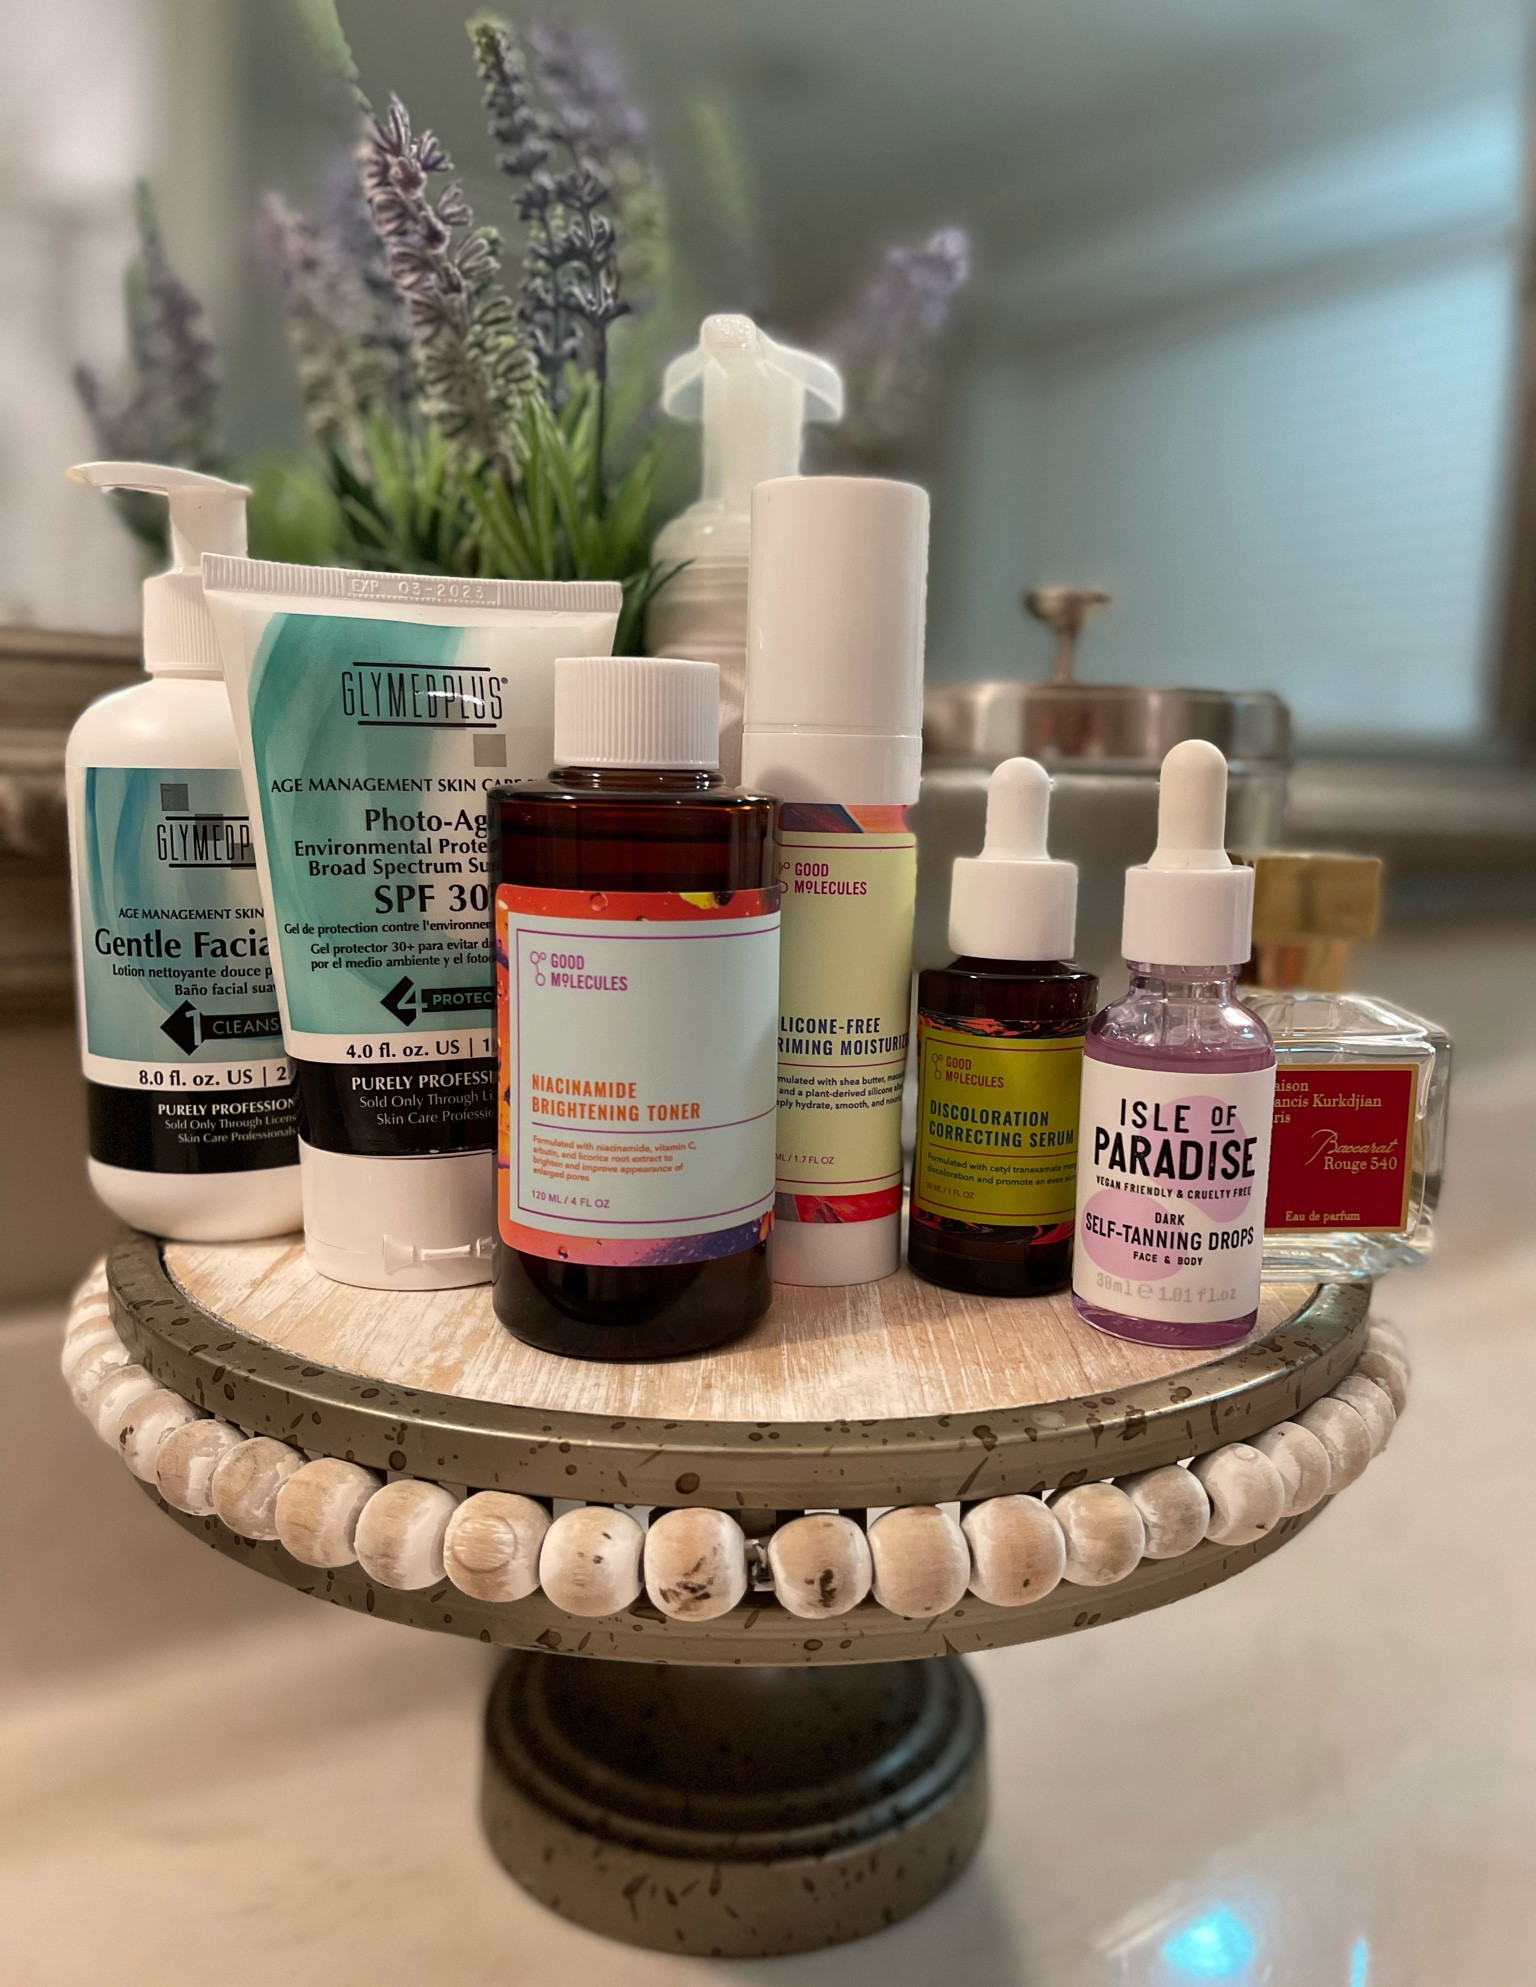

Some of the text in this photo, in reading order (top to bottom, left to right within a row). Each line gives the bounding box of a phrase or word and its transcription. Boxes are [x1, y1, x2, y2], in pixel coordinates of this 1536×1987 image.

[352, 578, 379, 593] EXP
[271, 777, 476, 793] AGE MANAGEMENT SKIN
[157, 824, 250, 861] GLYMEDP
[294, 837, 432, 857] Environmental
[308, 858, 462, 879] Broad Spectrum
[794, 862, 829, 877] GOOD
[374, 884, 435, 914] SPF
[119, 907, 264, 920] AGE MANAGEMENT SKIN
[284, 923, 300, 934] Gel
[302, 923, 315, 934] de
[318, 922, 378, 937] protection
[382, 921, 420, 933] contre
[95, 928, 181, 958] Gentle
[311, 939, 478, 957] Gel protector 30+ para evitar
[311, 959, 329, 972] por
[332, 958, 342, 968] el
[345, 956, 383, 968] medio
[386, 955, 440, 967] ambiente
[443, 956, 450, 968] y
[453, 953, 463, 964] el
[550, 953, 585, 970] GOOD
[112, 964, 261, 982] Lotion nettoyante douce
[175, 982, 248, 996] Baño facial
[213, 1015, 279, 1035] CLEANS
[780, 1016, 881, 1035] LICONE-FREE
[346, 1039, 460, 1059] 4.0 fl. oz. US
[946, 1056, 972, 1071] GOOD
[139, 1069, 253, 1086] 8.0 fl. oz. US
[352, 1075, 413, 1091] PURELY
[532, 1073, 637, 1099] NIACINAMIDE
[817, 1077, 837, 1086] with
[840, 1077, 860, 1086] shea
[862, 1076, 886, 1085] butter,
[360, 1090, 479, 1110] Sold Only Through
[779, 1087, 795, 1096] and
[805, 1088, 866, 1099] plant-derived
[868, 1087, 893, 1096] silicone
[158, 1103, 207, 1116] PURELY
[532, 1096, 700, 1122] BRIGHTENING TONER
[795, 1100, 833, 1110] hydrate,
[835, 1099, 870, 1109] smooth,
[871, 1099, 885, 1107] and
[1312, 1094, 1382, 1111] Kurkdjian
[377, 1112, 404, 1126] Skin
[408, 1112, 439, 1124] Care
[930, 1100, 1049, 1127] DISCOLORATION
[1120, 1098, 1237, 1133] ISLE OF
[165, 1119, 187, 1130] Sold
[190, 1119, 216, 1132] Only
[219, 1116, 262, 1129] Through
[178, 1126, 296, 1144] Skin Care Professionals
[929, 1120, 1074, 1148] CORRECTING SERUM
[533, 1135, 574, 1149] Formulated
[576, 1142, 594, 1151] with
[596, 1143, 652, 1153] niacinamide,
[654, 1143, 686, 1152] vitamin
[1305, 1128, 1398, 1165] Baccarat
[561, 1151, 577, 1160] and
[578, 1152, 609, 1163] licorice
[611, 1155, 630, 1163] root
[632, 1155, 662, 1163] extract
[664, 1154, 673, 1162] to
[808, 1156, 819, 1164] FL
[821, 1156, 834, 1164] OZ
[1094, 1126, 1257, 1181] PARADISE
[533, 1156, 684, 1175] brighten and improve appearance of
[928, 1152, 967, 1169] Formulated
[969, 1163, 988, 1171] with
[990, 1165, 1011, 1175] cetyl
[1013, 1165, 1061, 1174] tranexamate
[1324, 1156, 1398, 1174] Rouge 540
[533, 1167, 590, 1182] enlarged pores
[926, 1164, 974, 1182] discoloration
[977, 1176, 993, 1184] and
[996, 1178, 1033, 1187] promote
[1096, 1175, 1252, 1200] VEGAN FRIENDLY & CRUELTY FREE
[532, 1190, 610, 1209] 120 ML 4 FL OZ
[1155, 1212, 1185, 1225] DARK
[1285, 1210, 1360, 1224] Eau de parfum
[1085, 1212, 1254, 1251] SELF-TANNING DROPS
[1133, 1251, 1203, 1266] FACE & BODY
[1096, 1272, 1132, 1296] 30ml
[1159, 1286, 1192, 1303] 1.01
